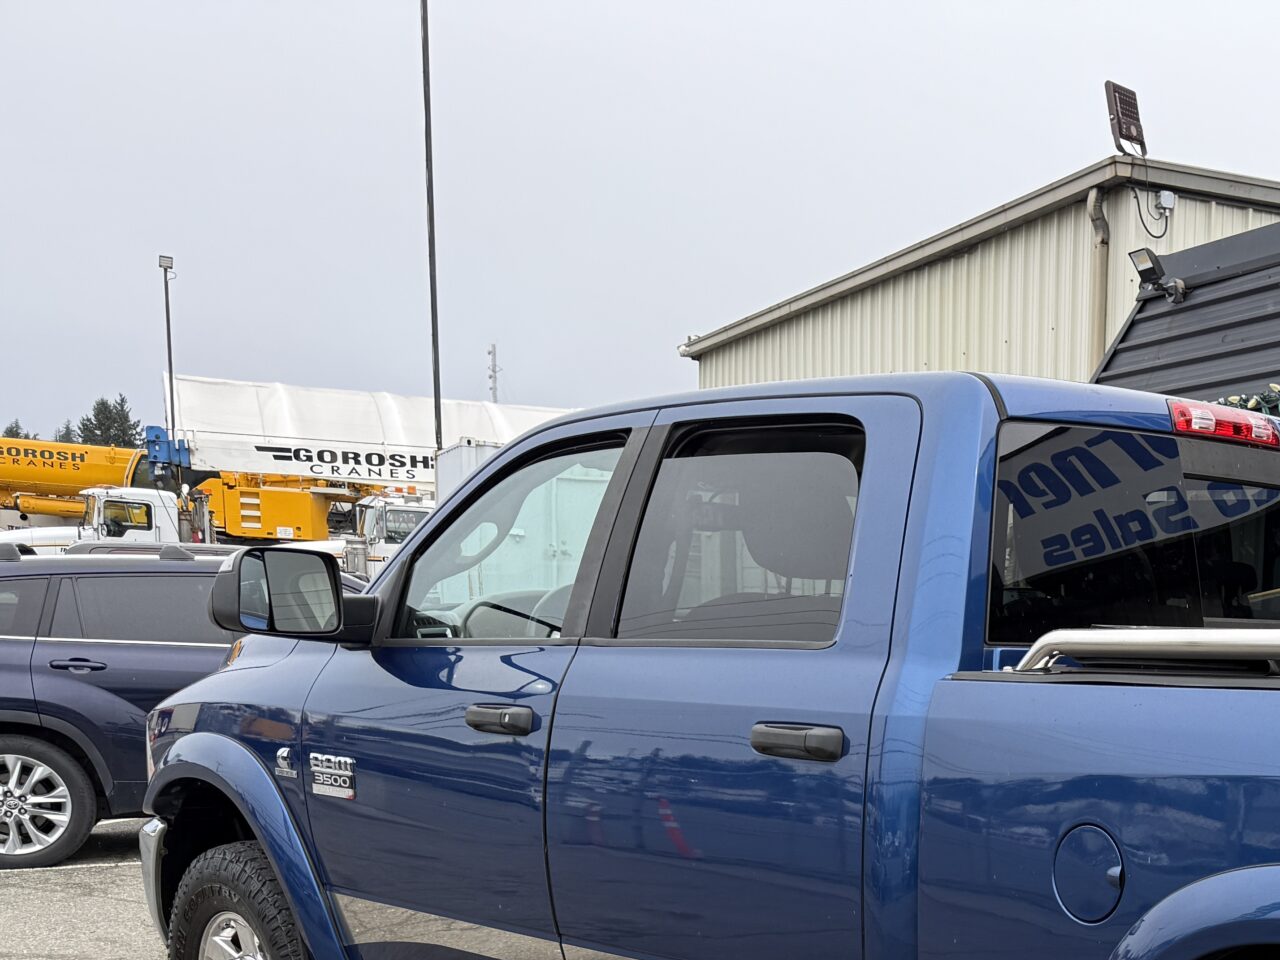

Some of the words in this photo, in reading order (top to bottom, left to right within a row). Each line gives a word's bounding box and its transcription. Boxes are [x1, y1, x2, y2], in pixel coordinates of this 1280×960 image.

[293, 447, 430, 469] GOROSH
[309, 463, 416, 480] CRANES
[314, 772, 349, 788] 3500
